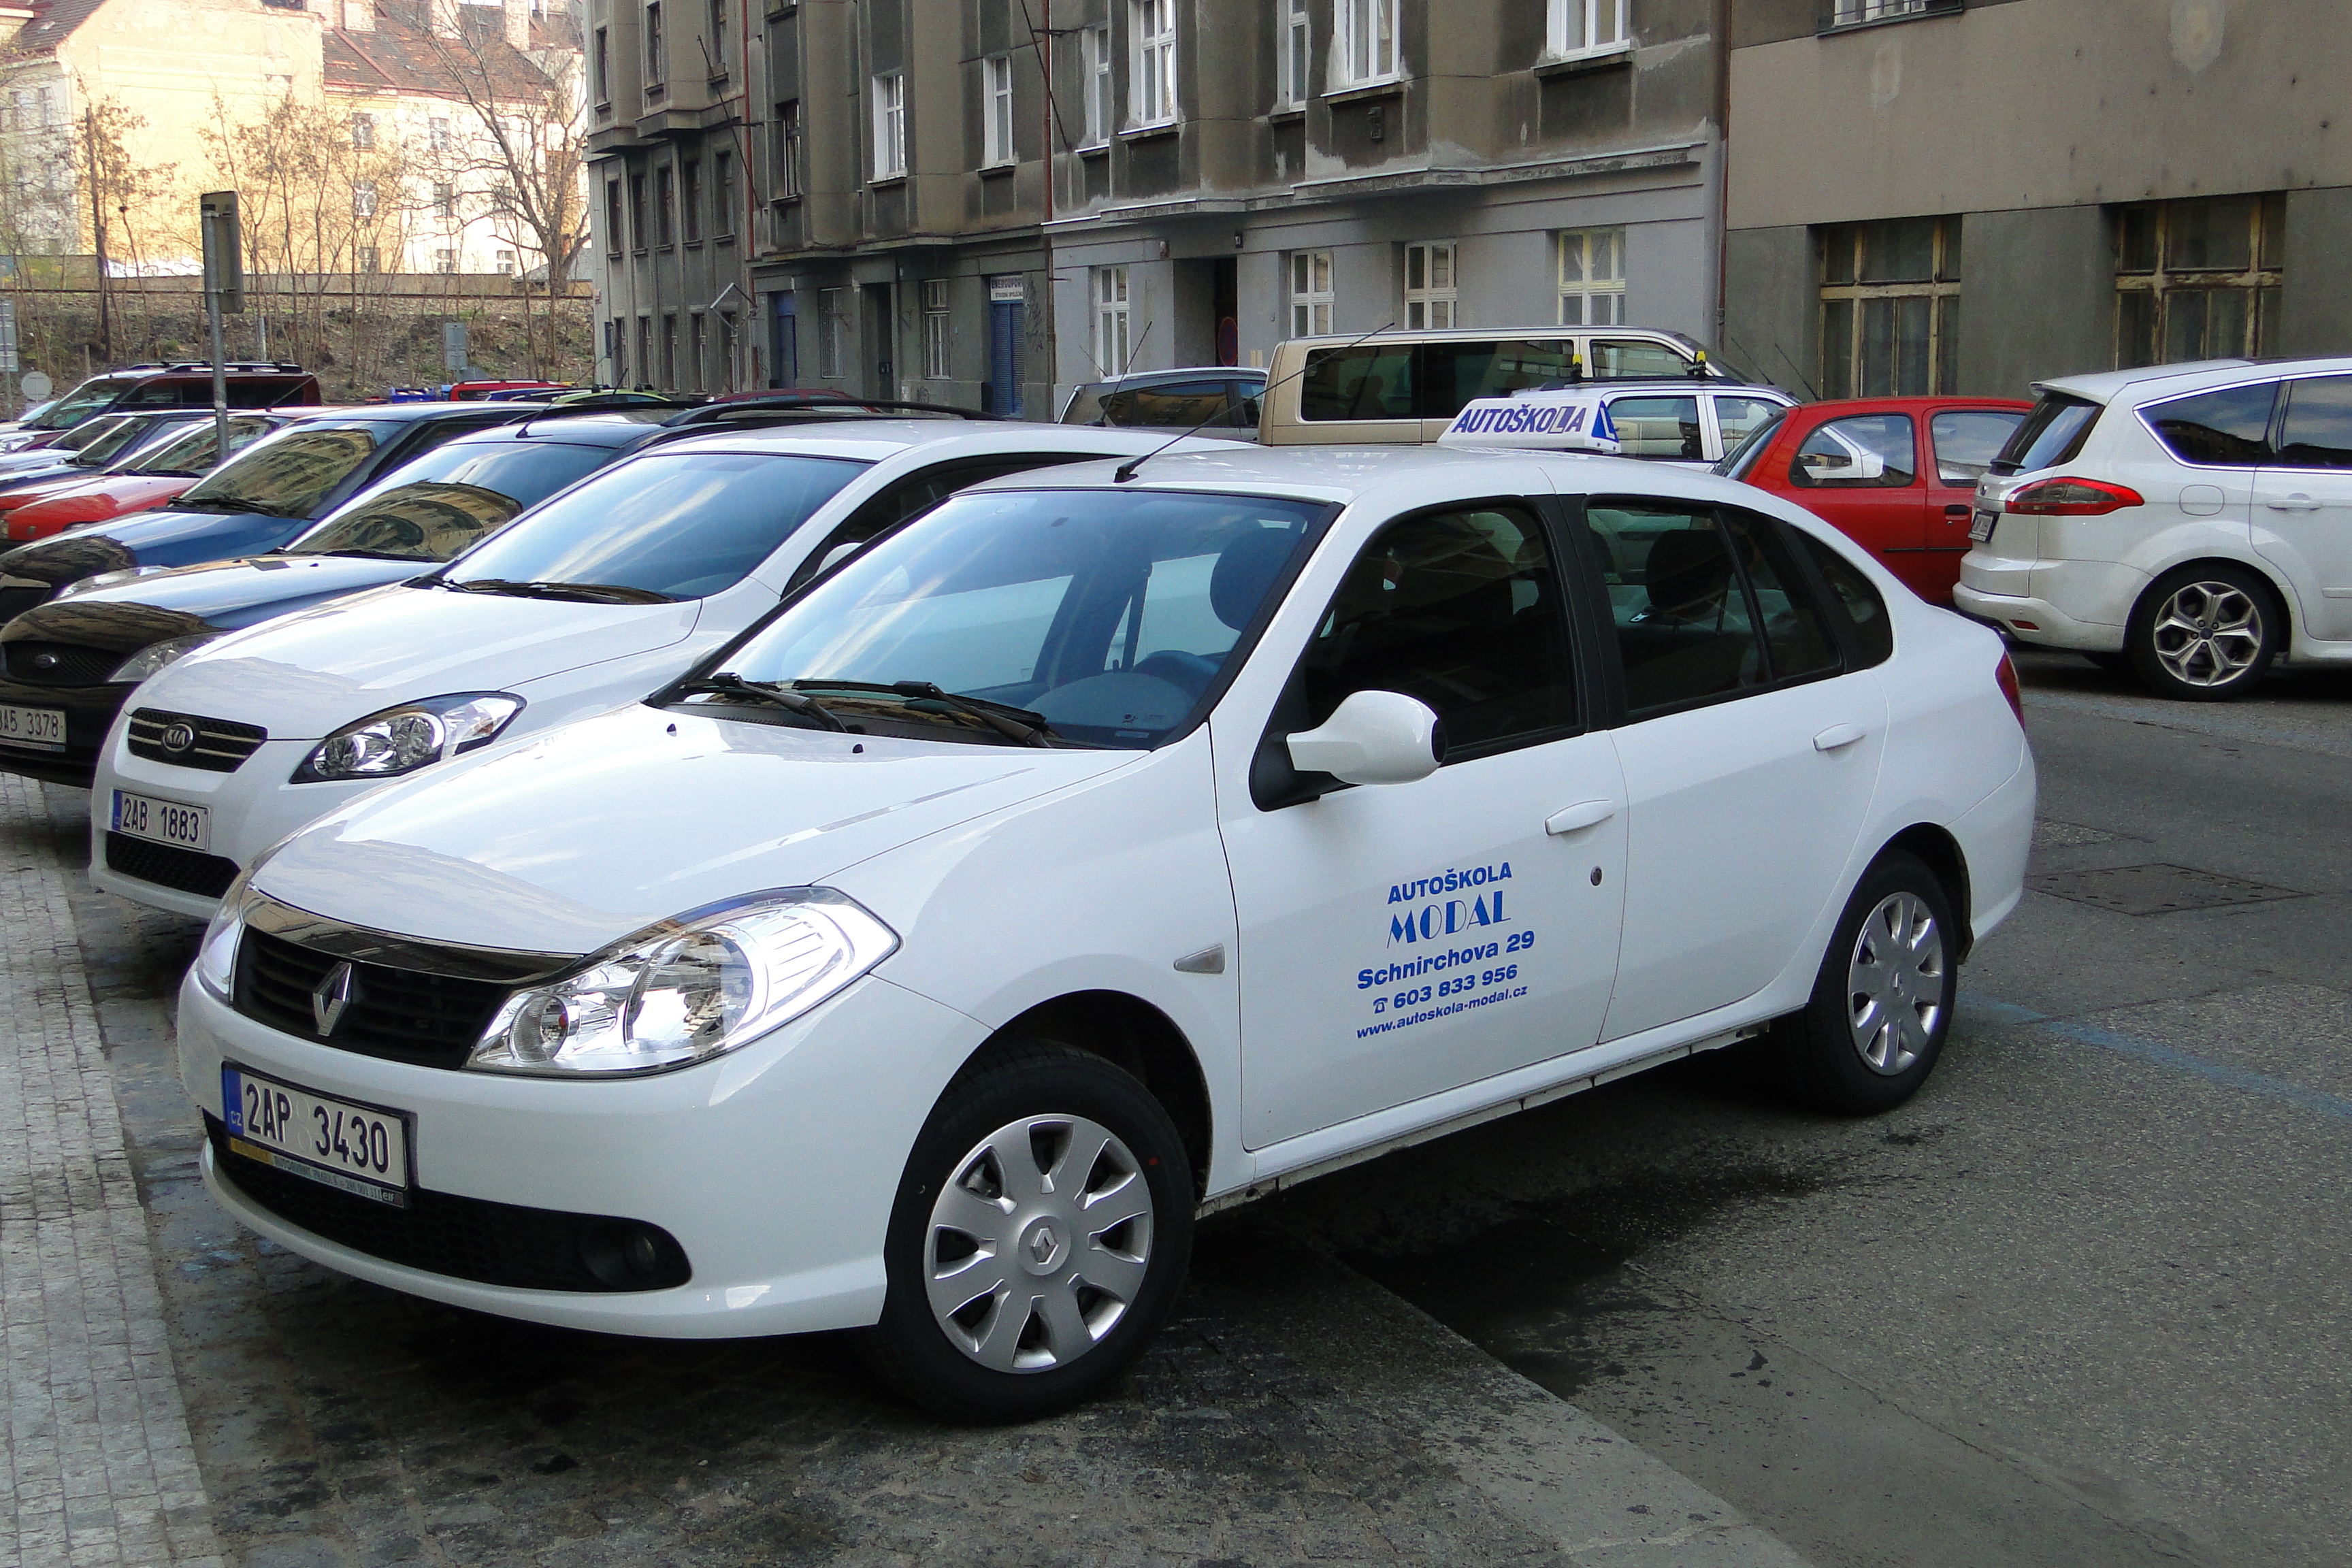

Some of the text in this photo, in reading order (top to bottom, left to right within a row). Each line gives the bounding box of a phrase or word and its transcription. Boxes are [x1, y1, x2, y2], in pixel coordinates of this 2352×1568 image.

[1450, 404, 1587, 434] AUTOŠKOLA
[27, 712, 59, 738] 3378
[167, 729, 186, 746] KIA
[123, 798, 199, 843] 2AB 1883
[1387, 862, 1512, 904] AUTOŠKOLA
[1386, 890, 1512, 949] MODAL
[1357, 930, 1535, 990] Schnirchova 29
[1393, 964, 1518, 1009] 603 833 956
[1356, 986, 1528, 1039] www.autoskola-modal.cz
[231, 1110, 242, 1126] CZ
[246, 1083, 292, 1142] 2AP
[314, 1105, 390, 1173] 3430
[382, 1192, 395, 1202] elf
